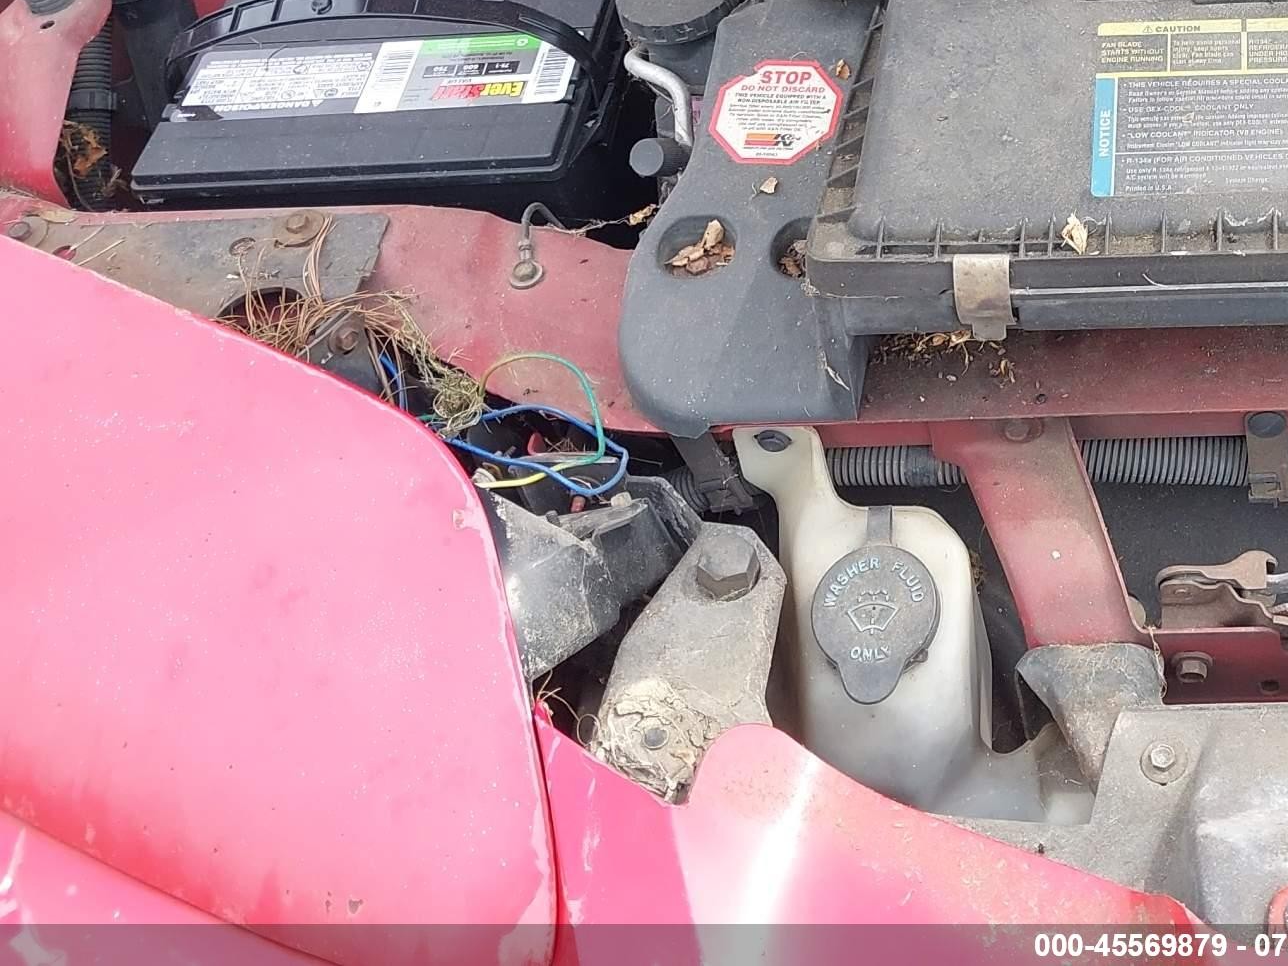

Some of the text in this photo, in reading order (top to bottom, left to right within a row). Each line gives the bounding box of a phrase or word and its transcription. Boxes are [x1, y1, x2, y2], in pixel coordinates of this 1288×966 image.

[1155, 25, 1201, 33] CAUTION
[1101, 48, 1130, 56] STARTS
[760, 70, 812, 85] STOP
[431, 80, 526, 100] EverStart
[781, 85, 826, 93] DISCARD
[1233, 103, 1254, 111] ONLY
[1098, 110, 1111, 158] NOTICE
[1189, 155, 1243, 163] CONDITIONED
[1244, 153, 1284, 161] VEHICLES
[823, 556, 925, 608] WASHER FLUID
[850, 645, 892, 663] ONLY
